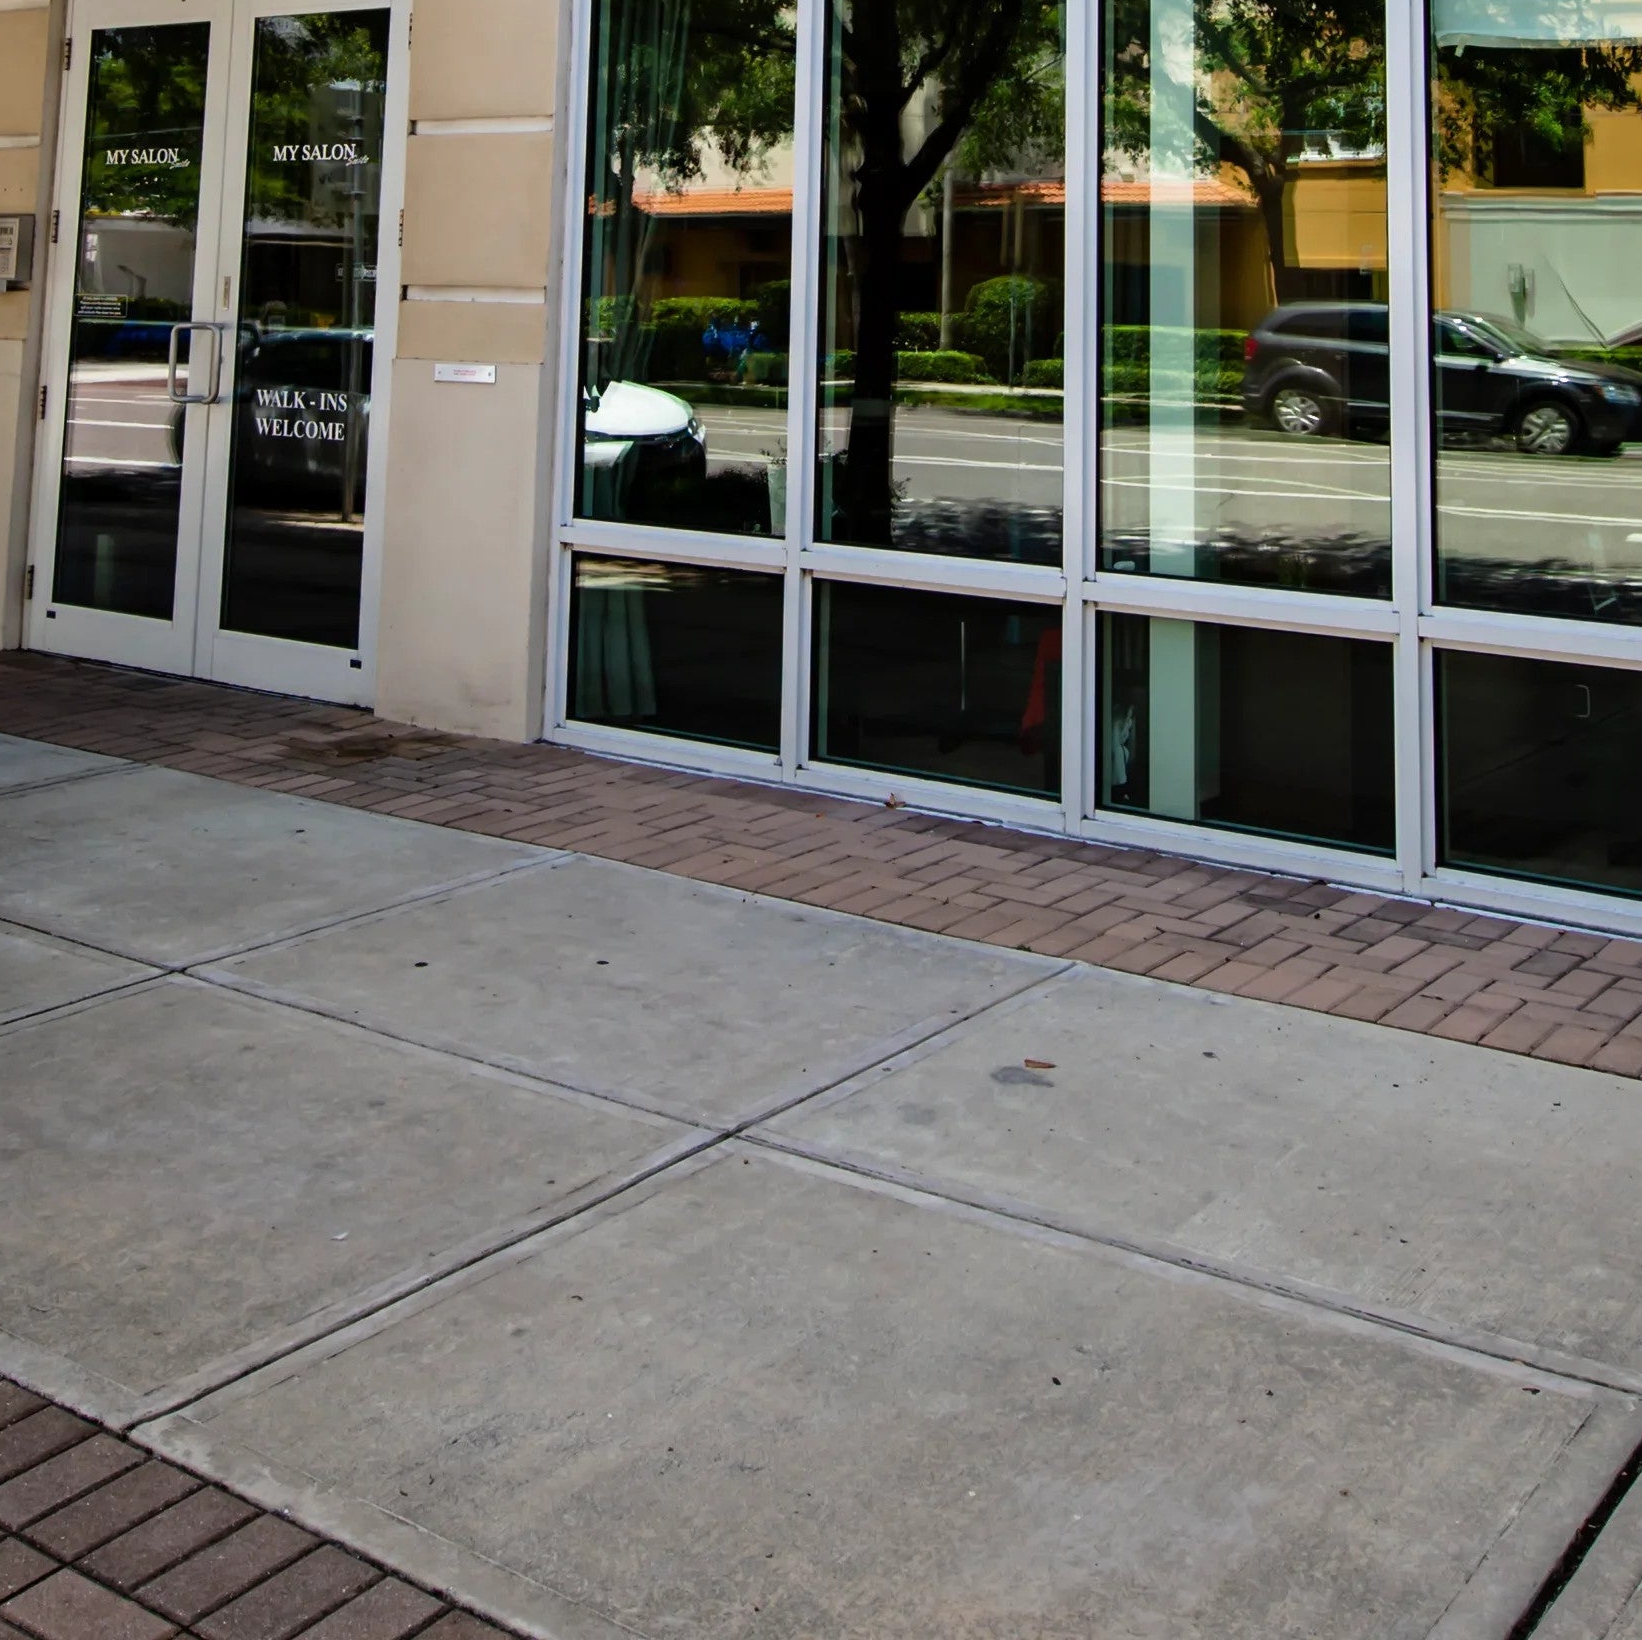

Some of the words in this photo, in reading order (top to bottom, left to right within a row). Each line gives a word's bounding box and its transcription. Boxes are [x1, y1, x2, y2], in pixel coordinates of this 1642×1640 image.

[105, 149, 130, 165] MY
[131, 147, 179, 165] SALON
[272, 145, 300, 162] MY
[301, 143, 357, 161] SALON
[257, 389, 307, 410] WALK
[319, 392, 348, 413] INS
[255, 417, 346, 441] WELCOME
